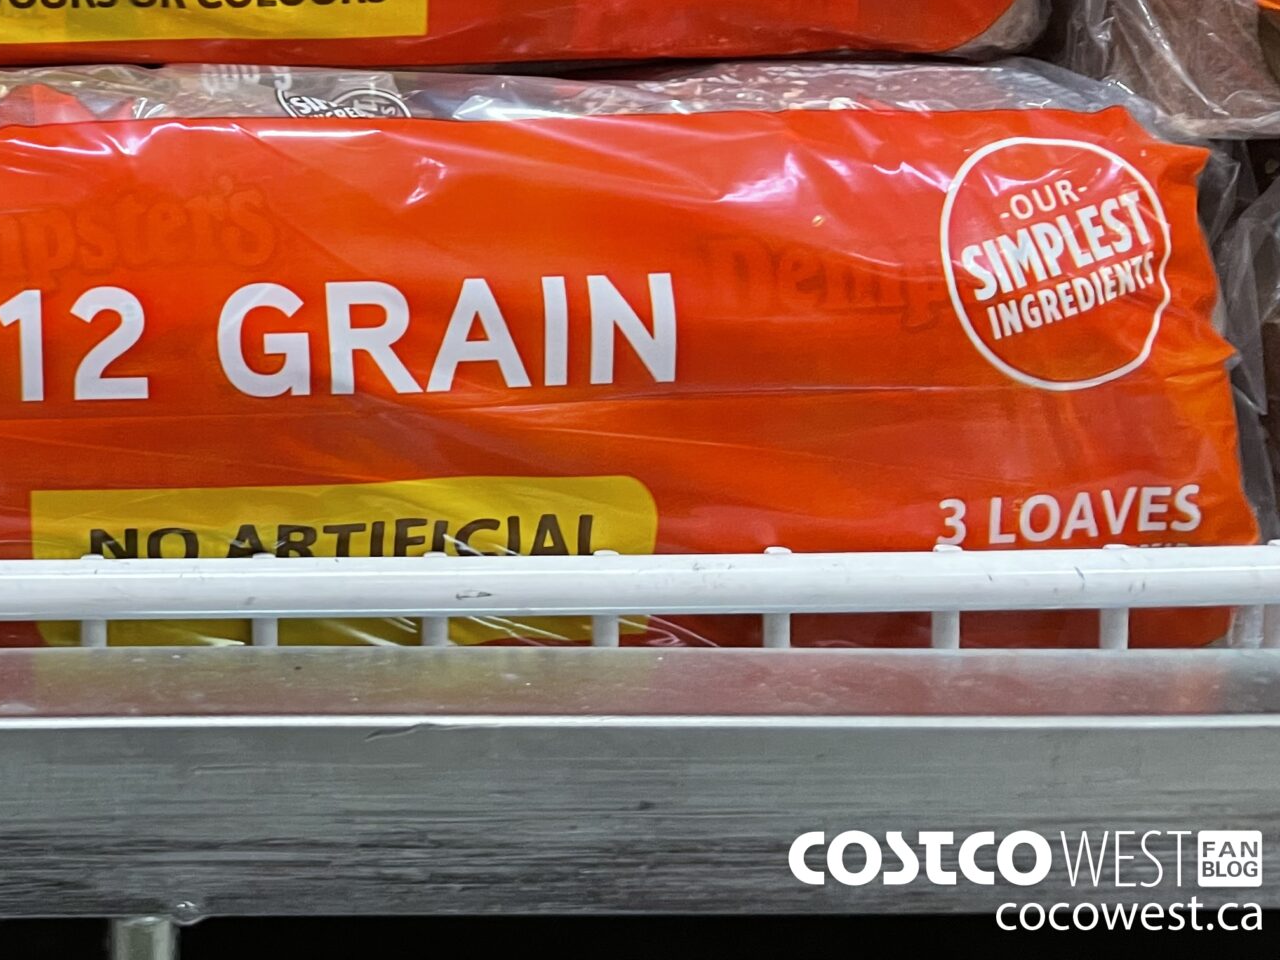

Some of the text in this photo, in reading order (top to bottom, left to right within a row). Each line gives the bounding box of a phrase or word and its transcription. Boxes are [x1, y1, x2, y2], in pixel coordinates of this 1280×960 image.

[962, 191, 1152, 302] SIMPLEST
[986, 250, 1155, 342] INGREDIENTS
[217, 271, 678, 399] GRAIN
[939, 485, 1202, 545] 3 LOAVES
